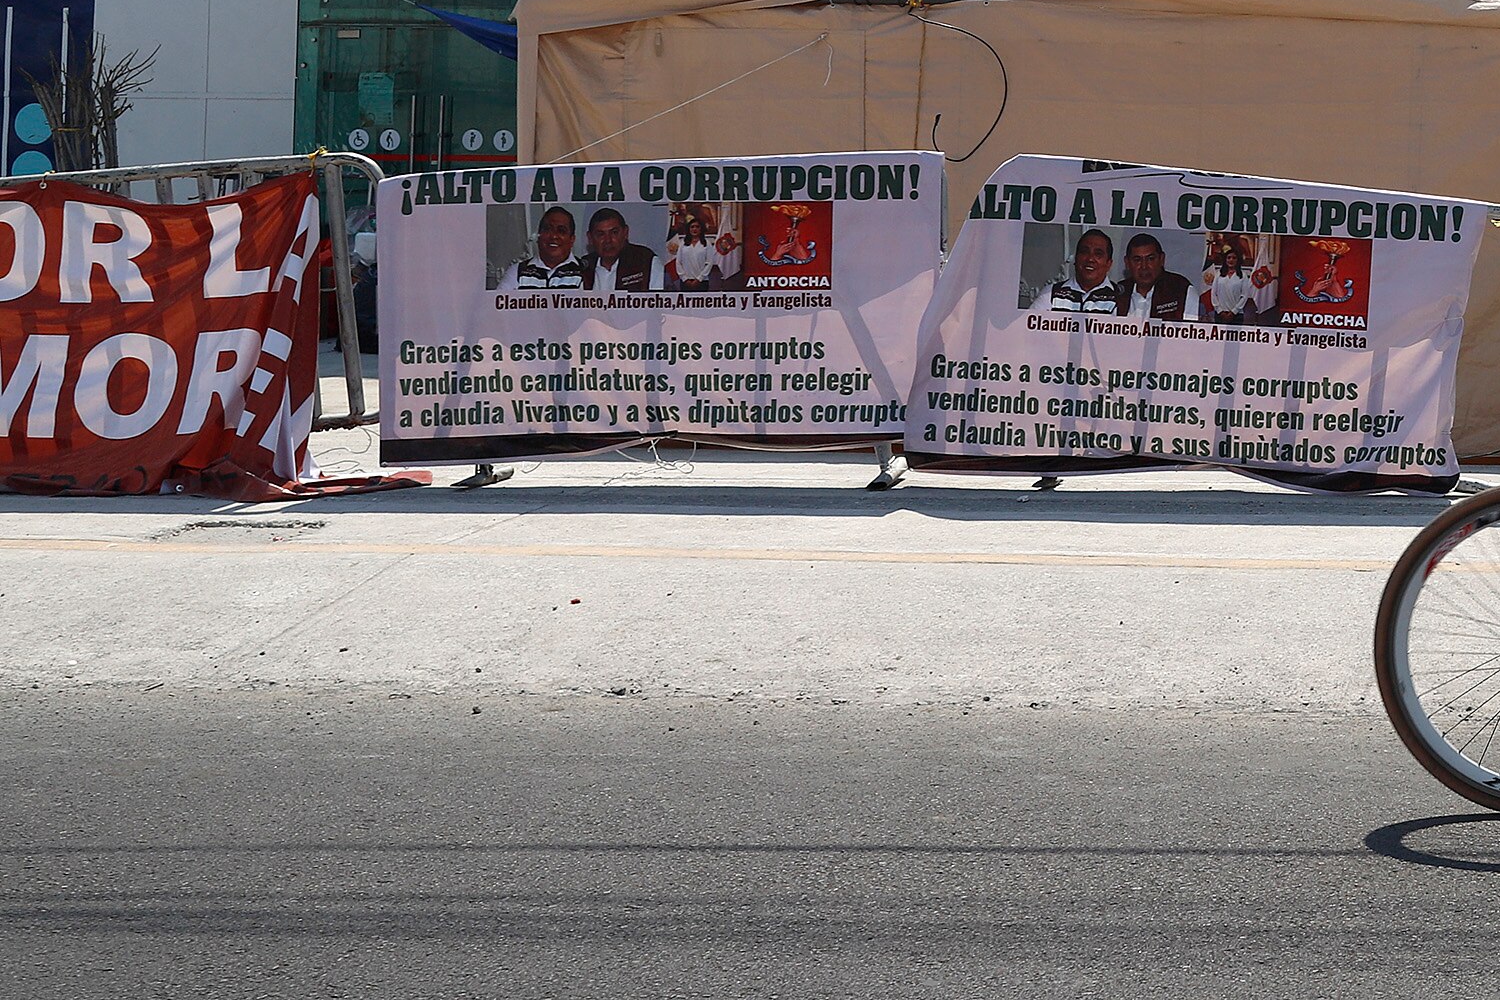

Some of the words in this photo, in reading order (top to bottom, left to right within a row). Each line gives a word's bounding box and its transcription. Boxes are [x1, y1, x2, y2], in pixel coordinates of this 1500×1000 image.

[402, 168, 516, 215] ¡ALTO
[530, 167, 559, 203] A
[570, 166, 626, 202] LA
[640, 164, 920, 202] CORRUPCION!
[1068, 188, 1097, 225] A
[1110, 190, 1162, 228] LA
[1177, 194, 1464, 242] CORRUPCION!
[746, 276, 830, 287] ANTORCHA
[495, 294, 548, 310] Claudia
[552, 293, 736, 311] Vivanco,Antorcha,Armenta
[740, 296, 749, 311] y
[753, 293, 832, 311] Evangelista
[1027, 314, 1079, 334] Claudia
[1084, 317, 1269, 345] Vivanco,Antorcha,Armenta
[1274, 332, 1283, 347] y
[1286, 328, 1367, 349] Evangelista
[1280, 312, 1366, 327] ANTORCHA
[400, 339, 484, 365] Gracias
[491, 343, 503, 362] a
[509, 337, 573, 362] estos
[579, 336, 703, 366] personajes
[710, 336, 825, 365] corruptos
[399, 368, 514, 396] vendiendo
[520, 367, 676, 396] candidaturas,
[684, 367, 772, 397] quieren
[781, 366, 872, 396] reelegir
[930, 353, 1012, 382] Gracias
[1018, 364, 1031, 383] a
[1038, 361, 1101, 387] estos
[1108, 368, 1234, 398] personajes
[1242, 376, 1358, 404] corruptos
[399, 409, 413, 428] a
[420, 400, 504, 427] claudia
[511, 400, 600, 425] Vivanco
[606, 404, 618, 427] y
[626, 404, 639, 423] a
[645, 404, 680, 423] sus
[927, 387, 1039, 415] vendiendo
[1047, 393, 1206, 430] candidaturas,
[1214, 408, 1304, 433] quieren
[1312, 407, 1405, 438] reelegir
[923, 423, 937, 442] a
[944, 418, 1026, 447] claudia
[1034, 422, 1122, 451] Vivanco
[1129, 434, 1141, 456] y
[1151, 437, 1163, 456] a
[1173, 438, 1210, 458] sus
[1343, 442, 1447, 470] corruptos
